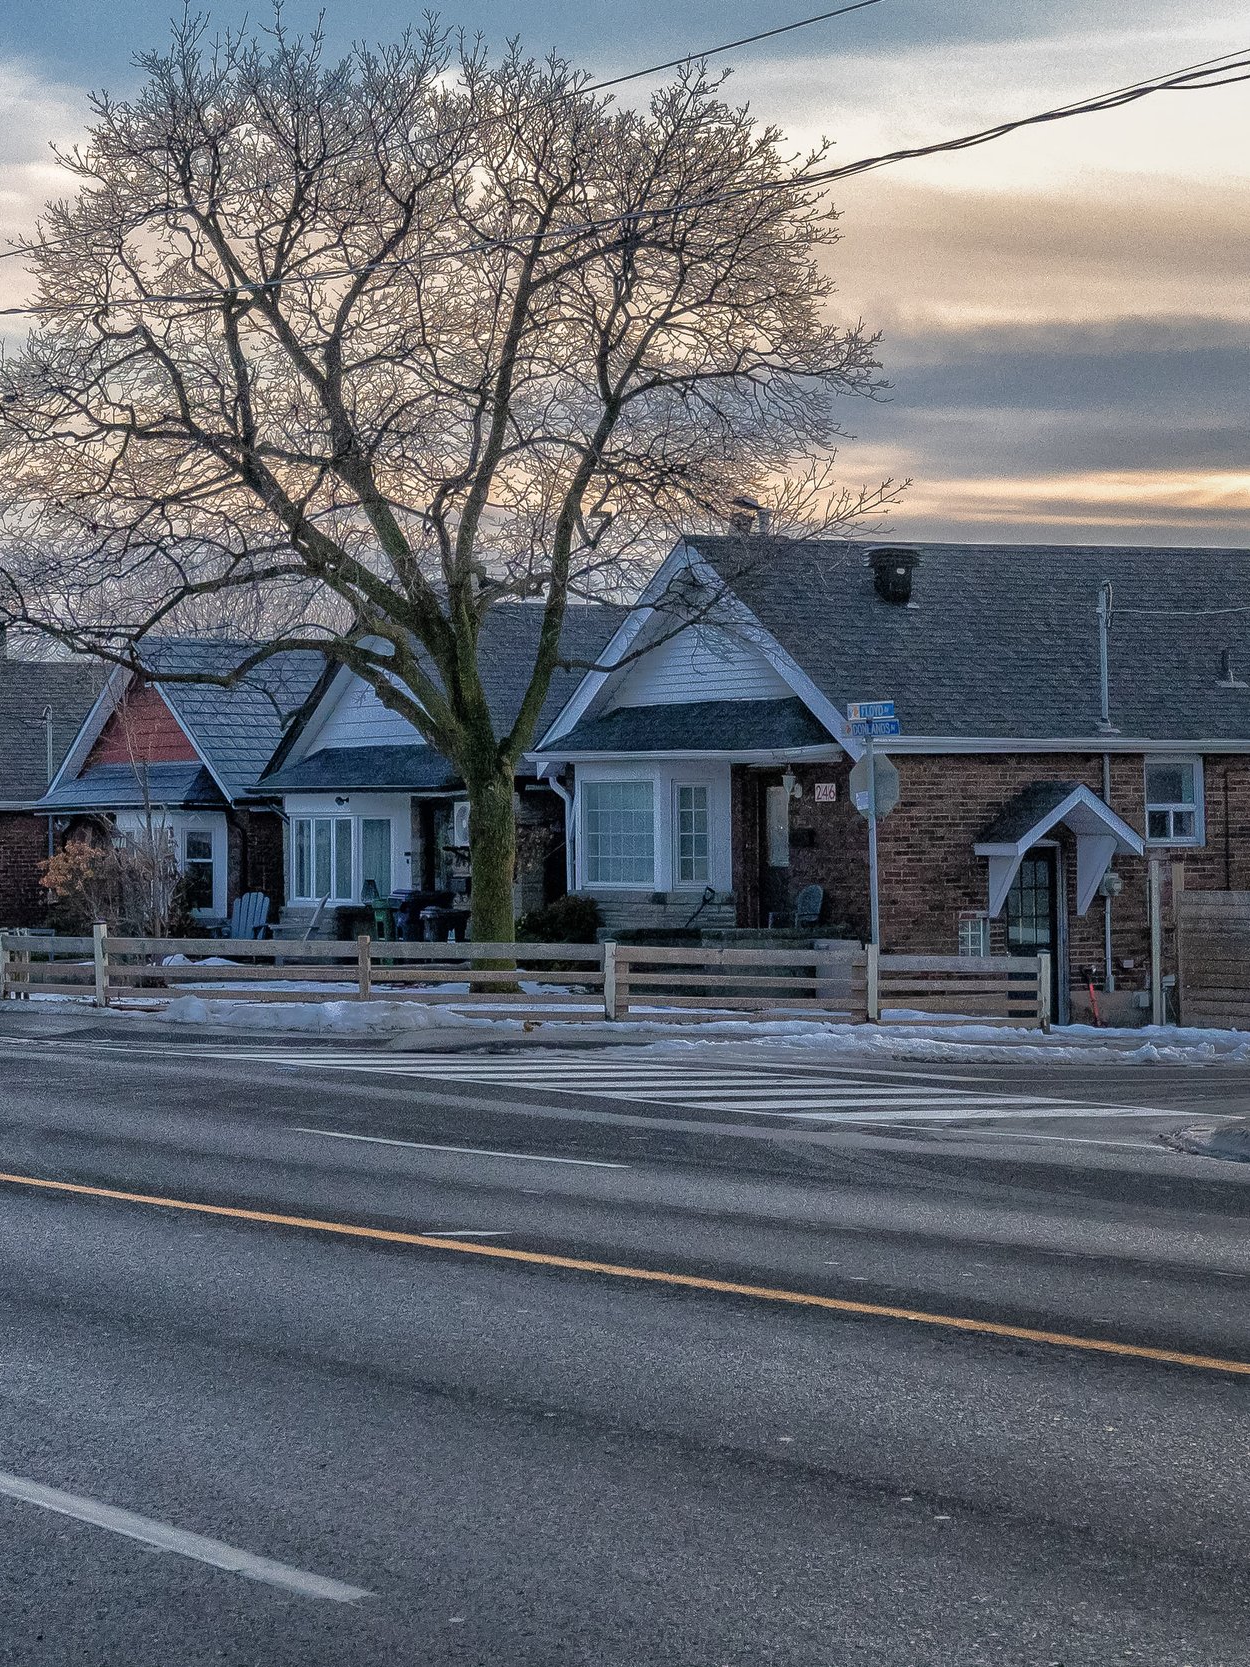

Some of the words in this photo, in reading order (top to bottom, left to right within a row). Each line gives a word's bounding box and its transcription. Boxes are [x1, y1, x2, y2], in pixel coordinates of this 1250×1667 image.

[862, 704, 883, 717] FLOYD
[853, 722, 890, 735] DONLANDS
[816, 785, 835, 800] 246
